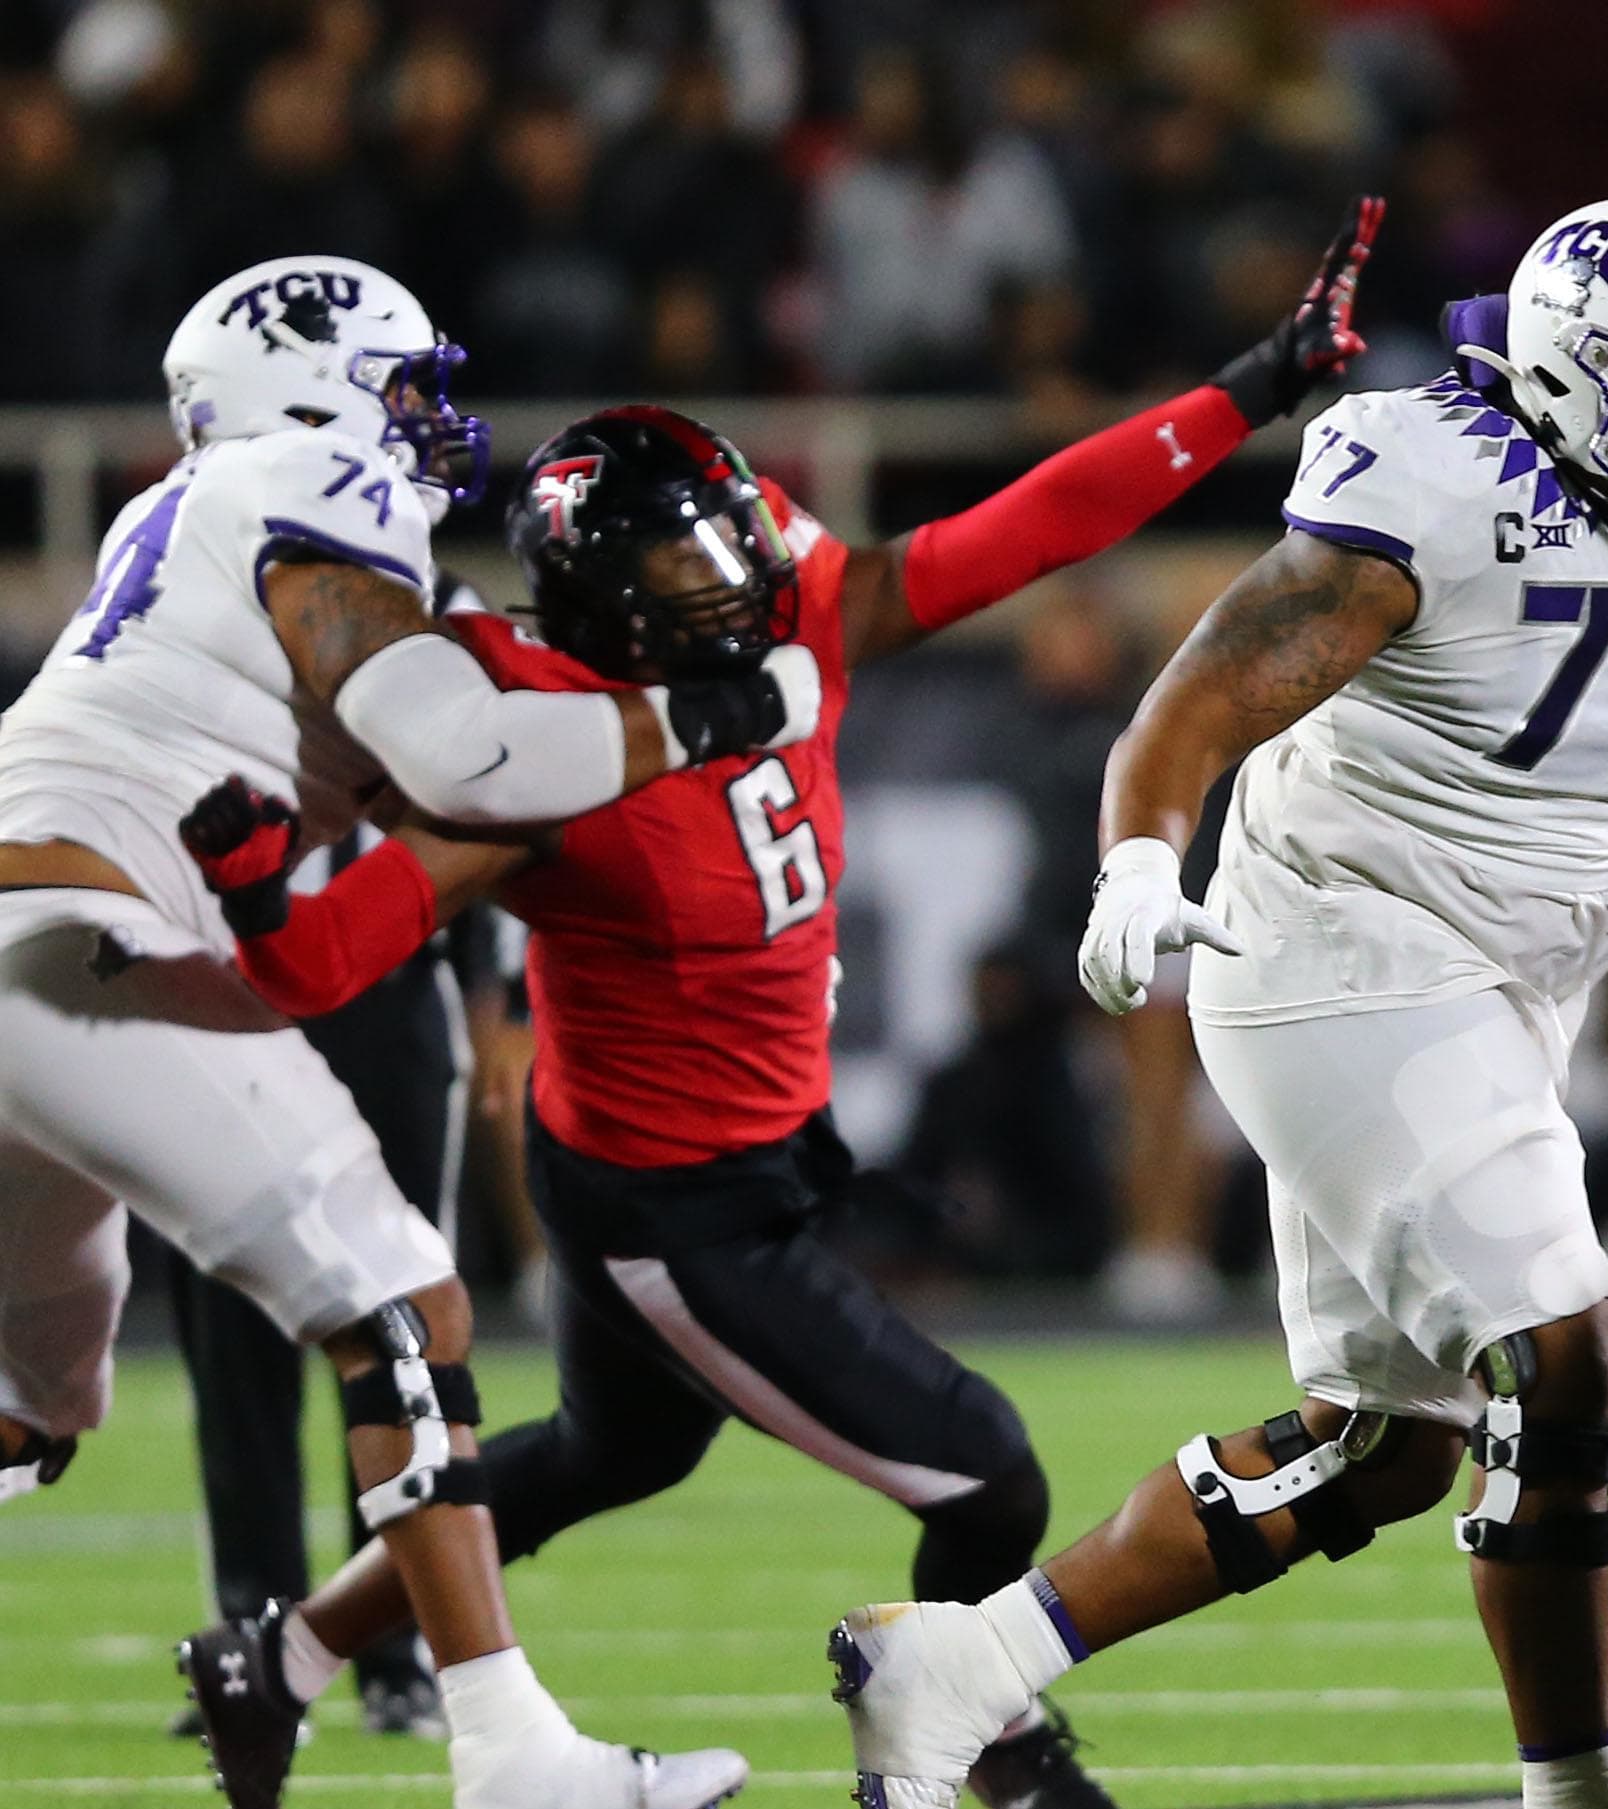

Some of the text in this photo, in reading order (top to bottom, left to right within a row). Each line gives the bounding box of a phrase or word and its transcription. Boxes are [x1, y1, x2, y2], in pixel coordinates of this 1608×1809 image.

[218, 272, 361, 330] TCU
[323, 451, 393, 528] 74
[1299, 425, 1379, 498] 77
[1494, 512, 1525, 563] C
[726, 752, 829, 943] 6
